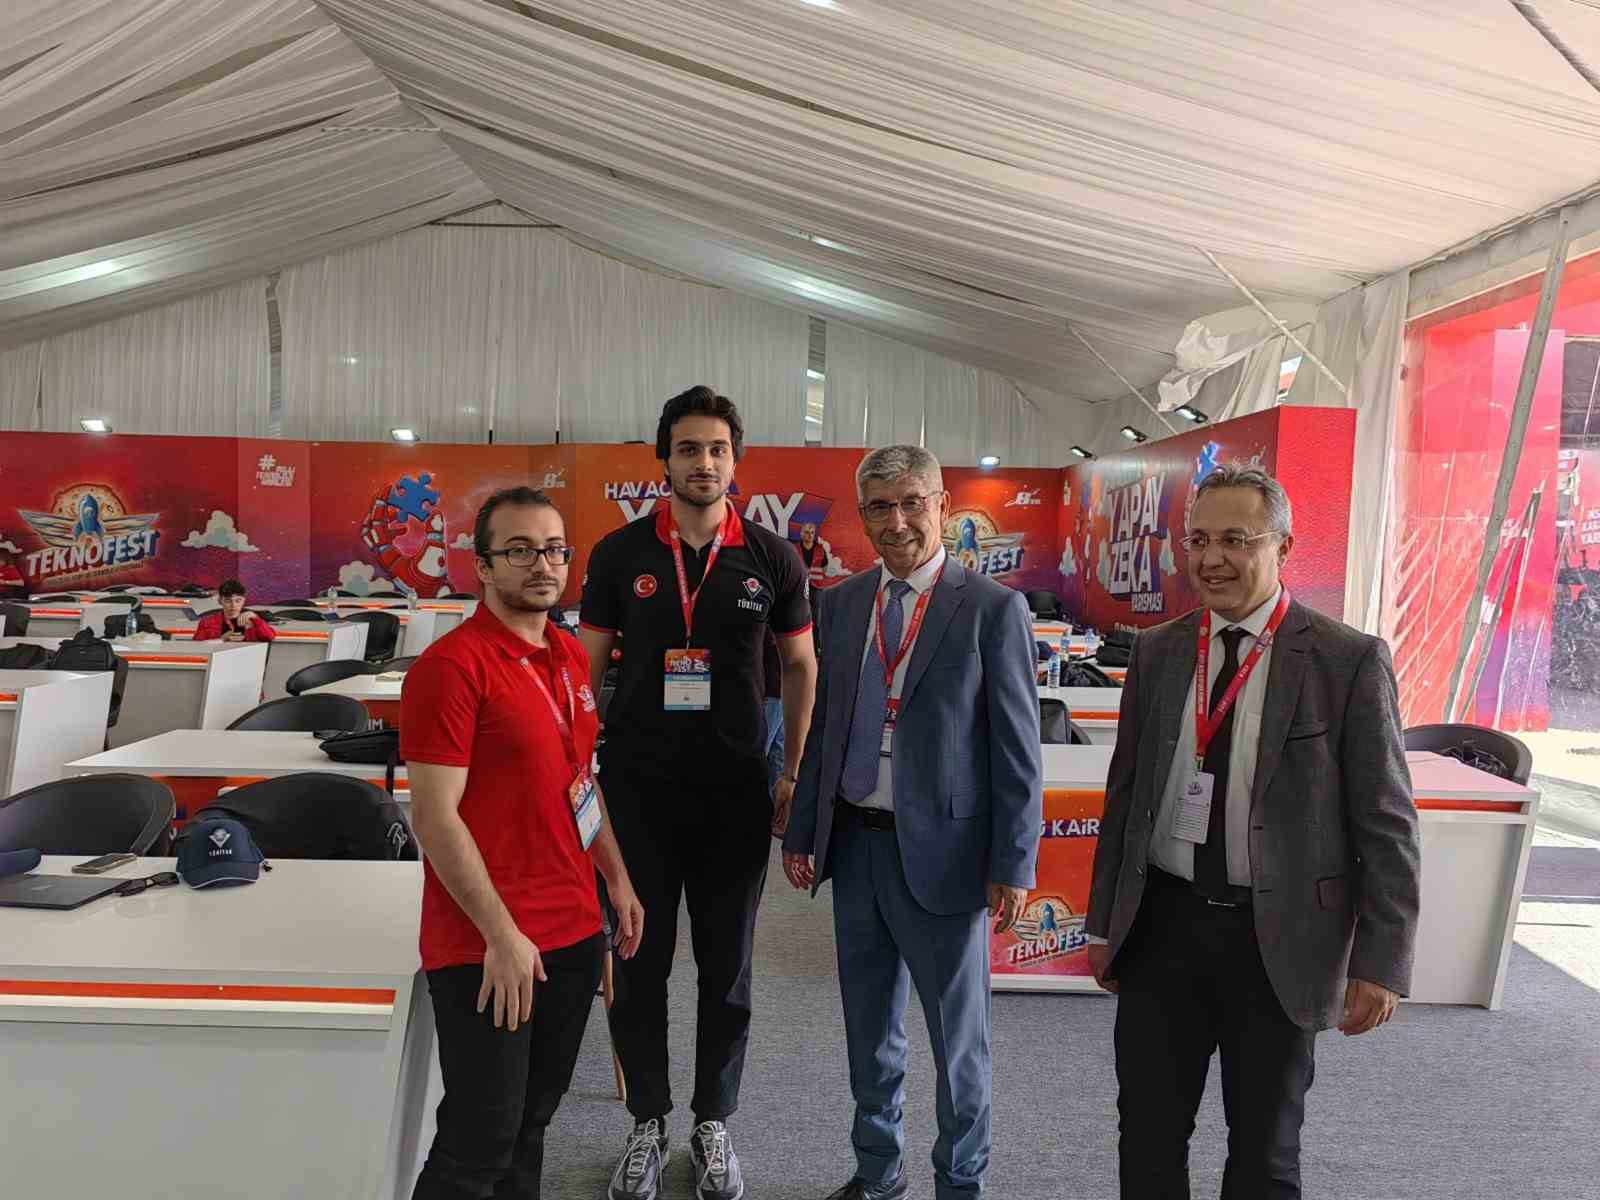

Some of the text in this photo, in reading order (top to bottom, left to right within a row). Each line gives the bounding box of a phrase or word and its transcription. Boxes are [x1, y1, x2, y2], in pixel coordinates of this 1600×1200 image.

[617, 492, 806, 540] YAY
[1106, 472, 1166, 543] YAPAY
[27, 529, 158, 577] TEKNOFEST
[1110, 536, 1152, 594] ZEKA
